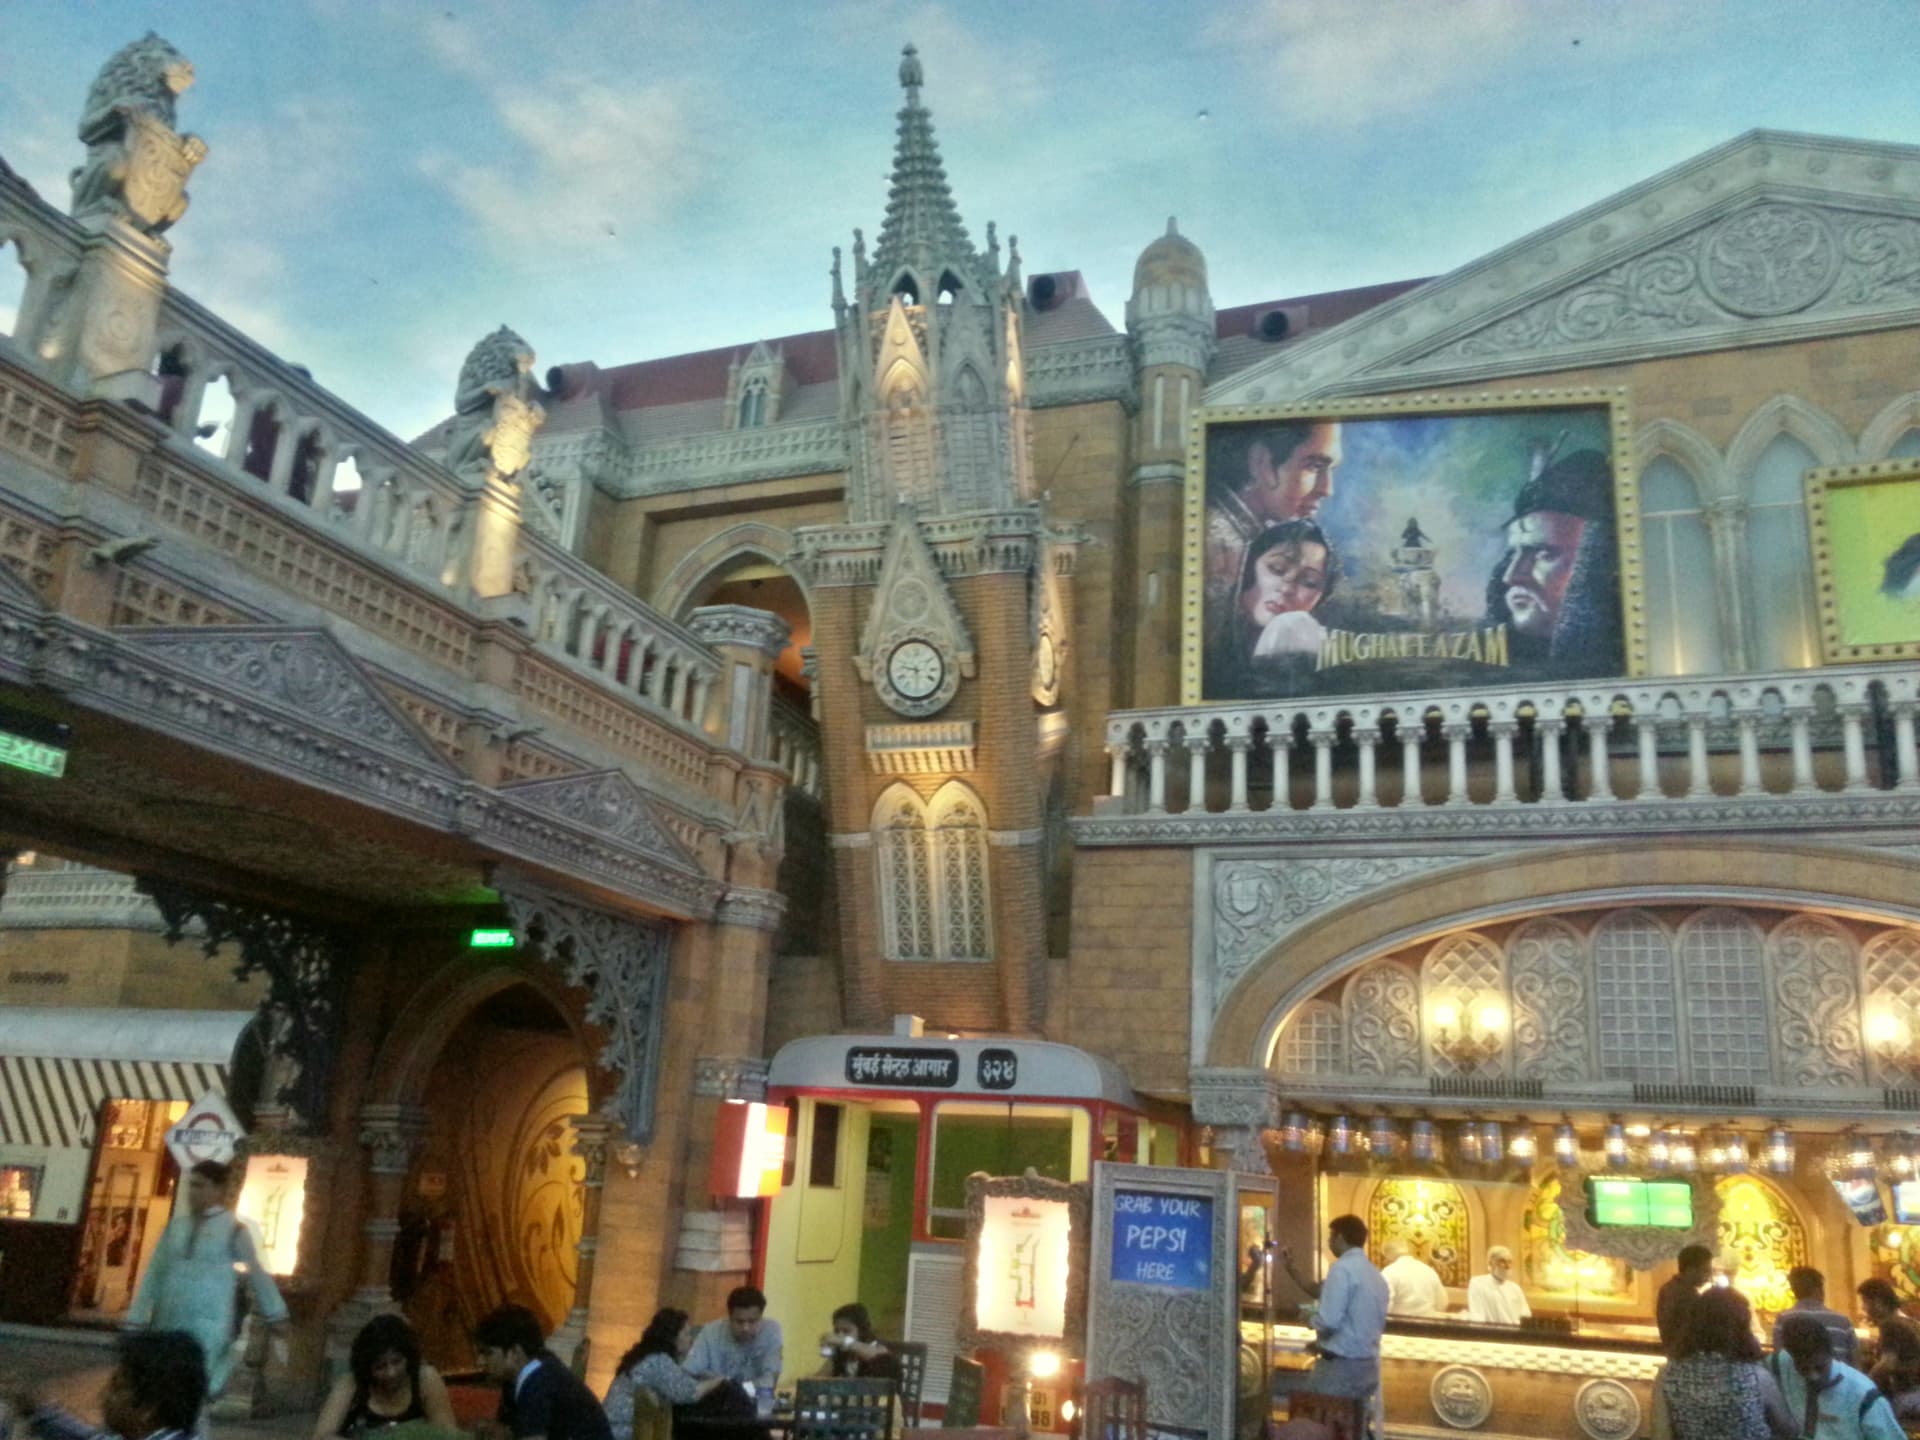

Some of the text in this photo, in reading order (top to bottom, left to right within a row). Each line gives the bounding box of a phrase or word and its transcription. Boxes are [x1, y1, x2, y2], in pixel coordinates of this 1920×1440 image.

[983, 1059, 1013, 1083] ३२४
[1114, 1194, 1201, 1218] GRAB YOUR
[1126, 1224, 1187, 1252] PEPSI
[1136, 1261, 1175, 1281] HERE
